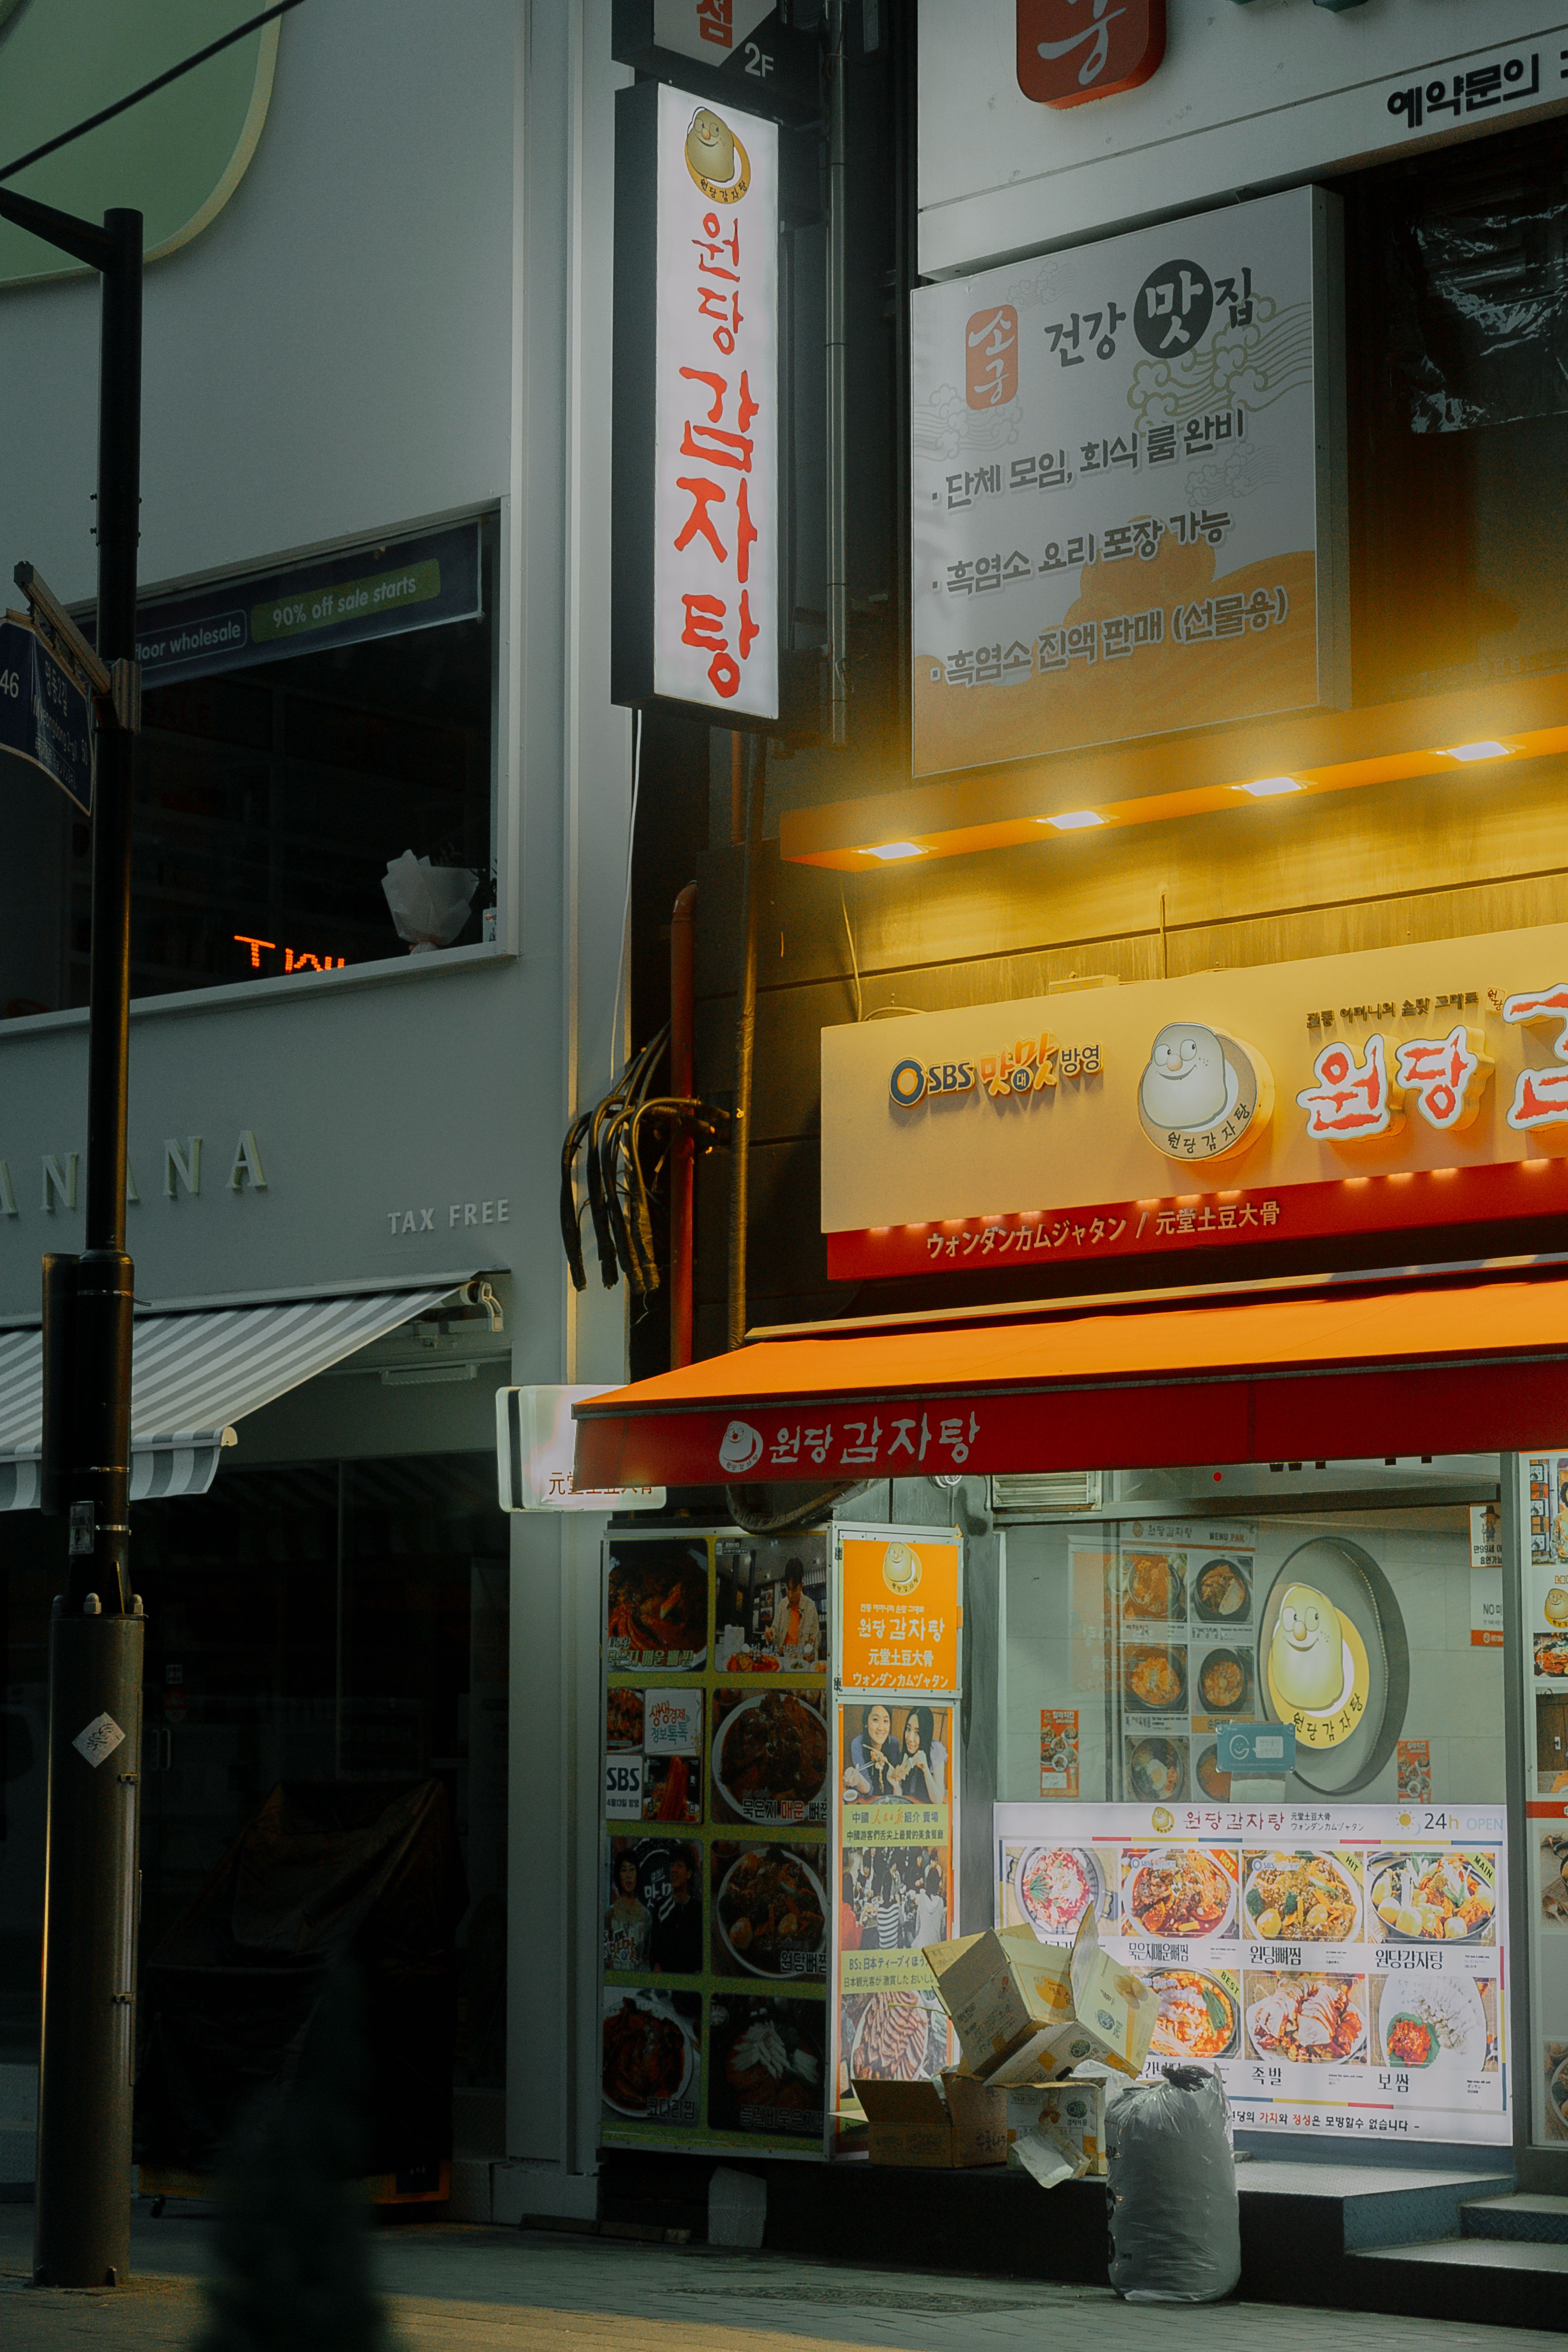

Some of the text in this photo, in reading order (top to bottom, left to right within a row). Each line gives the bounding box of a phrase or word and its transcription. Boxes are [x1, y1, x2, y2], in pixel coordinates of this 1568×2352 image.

[745, 42, 774, 78] 2F
[1387, 52, 1539, 128] 예약문의
[700, 178, 747, 203] 원당감자탕
[1044, 267, 1254, 368] 건강 맛집
[673, 212, 760, 699] 원당감자탕
[946, 408, 1244, 509] 단체 모임, 회식 룸 완비
[947, 509, 1231, 594] 흑염소 요리 포장 가능
[170, 621, 241, 654] wholesale
[272, 602, 307, 628] 90%
[312, 595, 334, 620] off
[338, 587, 369, 613] sale
[372, 575, 417, 604] starts
[947, 588, 1288, 684] 흑염소 진액 판매 (선물용)
[45, 660, 68, 717] 명동2길
[1306, 1010, 1334, 1029] 전통
[1340, 1002, 1396, 1023] 어머니의
[1401, 997, 1431, 1017] 손맛
[1434, 991, 1479, 1011] 그대로
[928, 1061, 974, 1092] SBS
[1061, 1043, 1101, 1074] 방영
[1167, 1103, 1251, 1154] 원당감자탕
[387, 1199, 510, 1235] TAX FREE
[926, 1217, 1126, 1259] ウォンダンカムジャタン
[1155, 1201, 1280, 1236] 元堂土豆大骨
[769, 1411, 980, 1465] 원당감자탕
[1209, 1532, 1229, 1541] MENU
[1473, 1544, 1495, 1554] 만99세
[1483, 1604, 1495, 1615] NO
[857, 1616, 945, 1643] 원당감자탕
[642, 1649, 665, 1667] 매운
[868, 1648, 934, 1668] 元堂土豆大骨
[649, 1700, 686, 1727] 생생경제
[1293, 1693, 1363, 1742] 원당감자탕
[651, 1721, 688, 1745] 정보톡톡
[606, 1767, 640, 1792] SBS
[742, 1799, 777, 1819] 묵은지
[780, 1800, 804, 1820] 매운
[852, 1812, 869, 1824] 中國
[904, 1811, 920, 1823] 紹介
[1182, 1810, 1285, 1830] 원당감자탕
[1290, 1812, 1331, 1822] 元堂土豆大骨
[1423, 1813, 1504, 1831] 24h OPEN
[1218, 1853, 1236, 1873] HOT
[1345, 1856, 1360, 1873] HIT
[1473, 1855, 1493, 1879] MAIN
[1128, 1943, 1189, 1962] 묵은지매운뼈찜
[1249, 1945, 1302, 1966] 원당뼈찜
[1375, 1949, 1444, 1970] 원당감자탕
[1220, 1971, 1240, 1995] BEST
[1252, 2066, 1283, 2087] 족발
[1377, 2073, 1410, 2093] 보쌈
[1259, 2111, 1288, 2125] 가치와
[1293, 2113, 1321, 2127] 정성은
[1325, 2115, 1364, 2129] 모방할수
[1368, 2118, 1408, 2132] 없습니다
